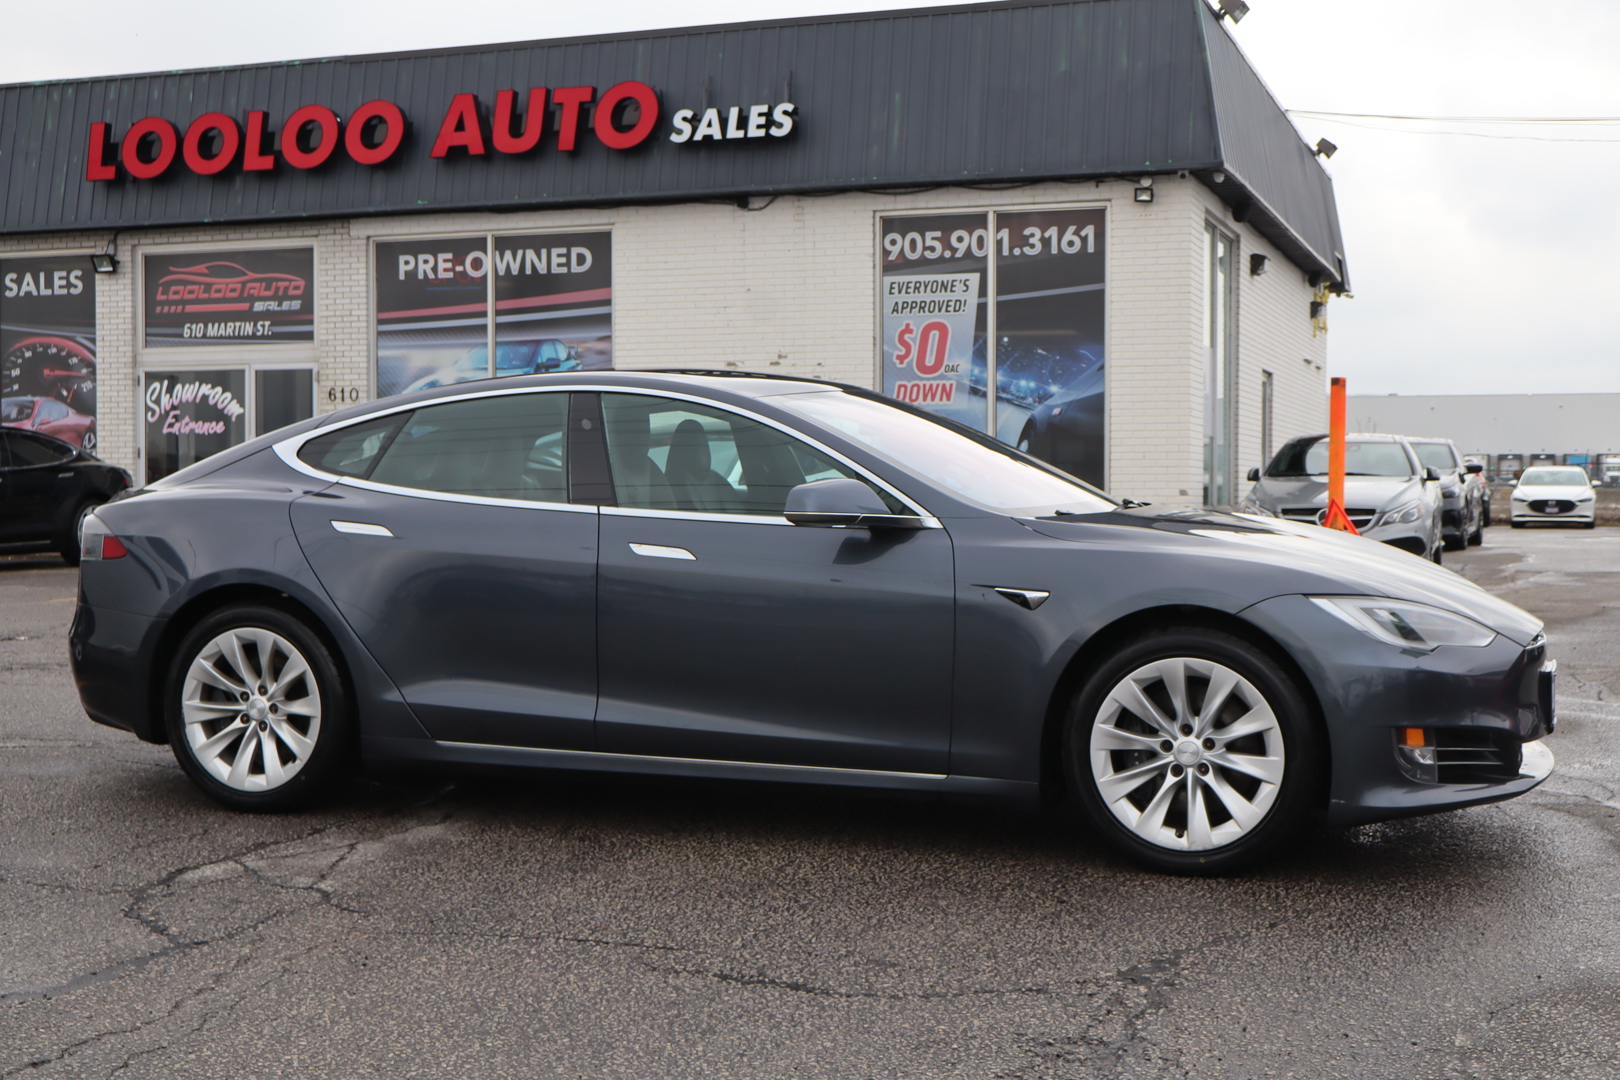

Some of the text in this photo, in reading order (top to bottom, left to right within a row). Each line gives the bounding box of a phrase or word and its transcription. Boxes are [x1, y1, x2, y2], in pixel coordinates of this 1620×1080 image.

[86, 80, 795, 181] LOOLOO AUTO SALES
[883, 224, 1095, 261] 905.901.3161
[398, 247, 593, 281] PRE-OWNED
[4, 269, 84, 298] SALES
[156, 280, 306, 301] LOOLOO AUTO
[888, 279, 971, 296] EVERYONE'S
[252, 300, 303, 312] SALES
[890, 299, 967, 315] APPROVED!
[183, 321, 273, 338] 610 MARTIN ST.
[895, 321, 960, 376] $0 OAC
[146, 379, 245, 423] Showroom
[327, 386, 360, 403] 610
[896, 382, 954, 403] DOWN
[162, 410, 226, 436] Entrance
